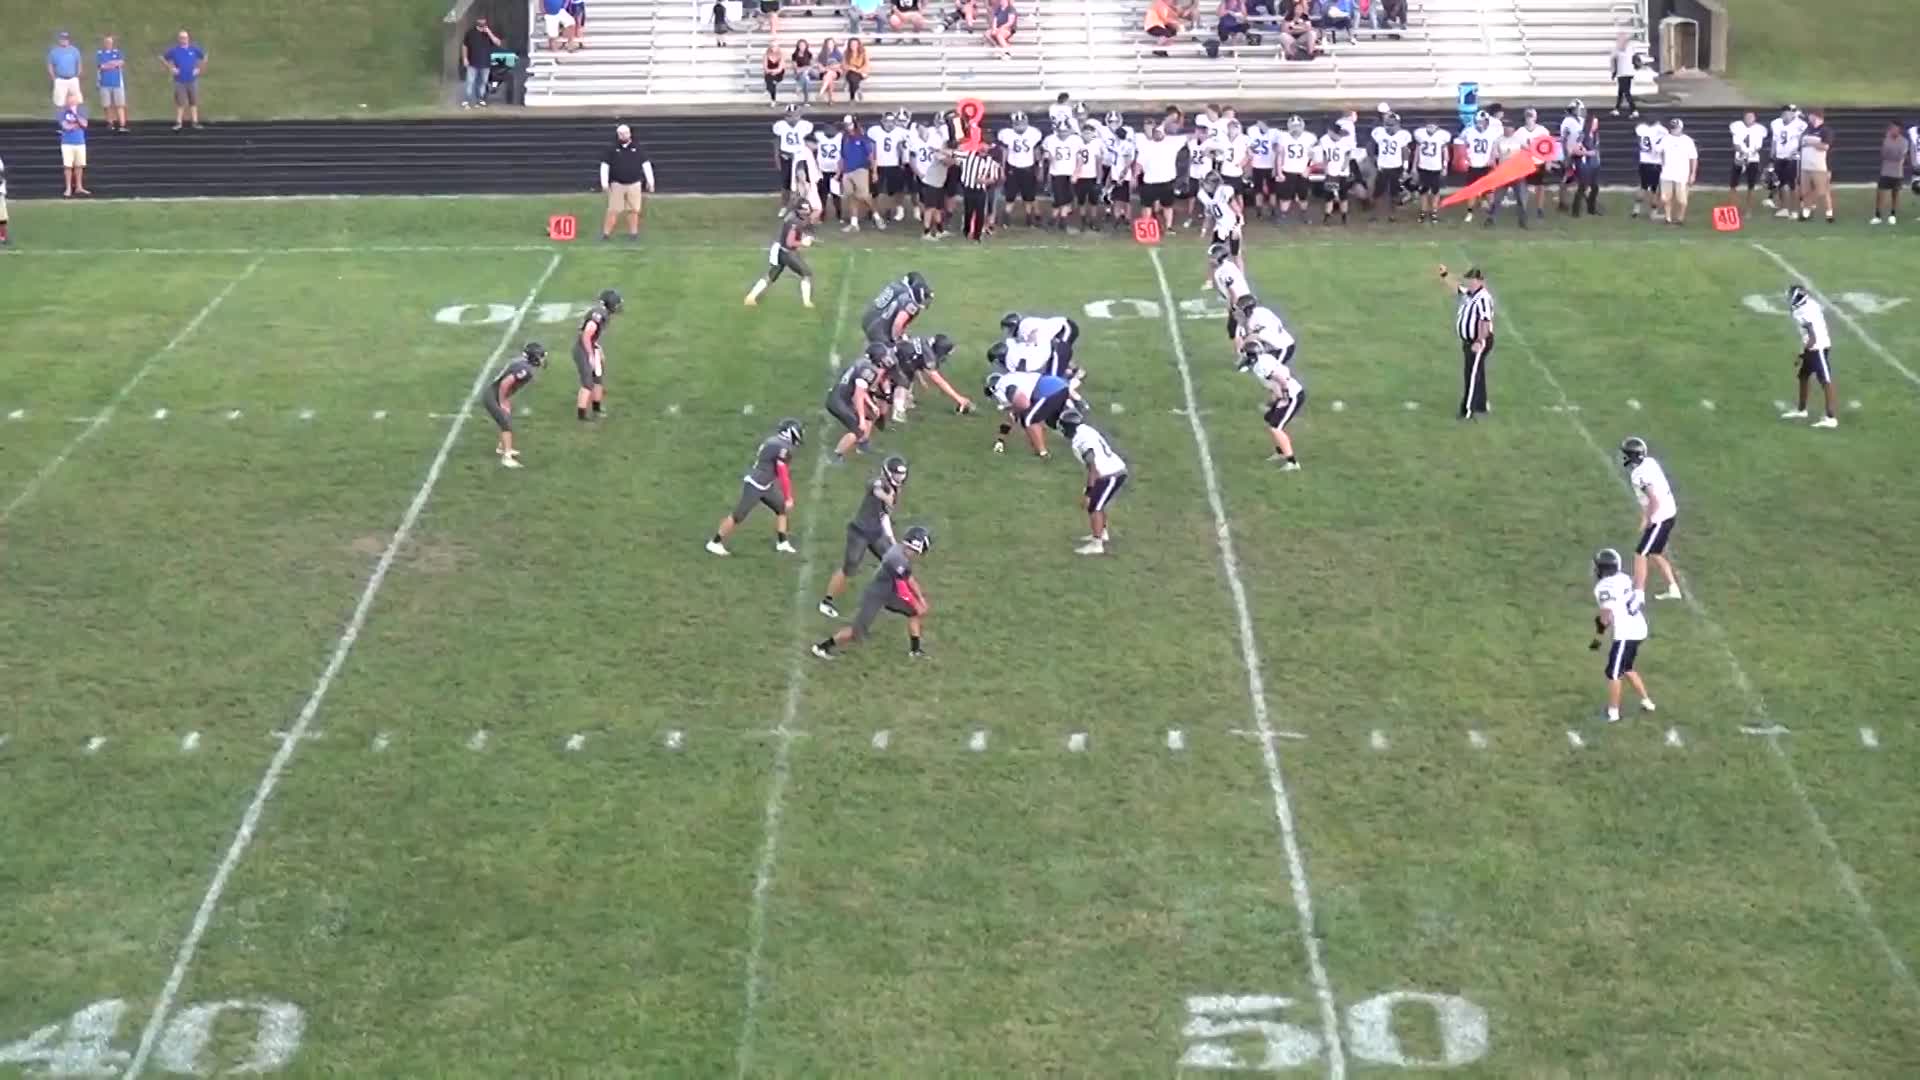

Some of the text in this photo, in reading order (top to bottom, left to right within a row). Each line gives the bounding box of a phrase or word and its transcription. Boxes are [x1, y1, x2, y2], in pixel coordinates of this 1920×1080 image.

[820, 144, 837, 159] 52
[883, 138, 891, 151] 6
[1013, 138, 1031, 153] 65
[1253, 138, 1269, 155] 25
[1287, 144, 1304, 159] 53
[1382, 138, 1398, 155] 39
[1421, 141, 1437, 157] 23
[1474, 138, 1489, 154] 20
[1718, 209, 1737, 225] 40
[554, 218, 573, 236] 40
[1137, 221, 1158, 239] 50
[0, 996, 307, 1078] 40
[1177, 990, 1489, 1071] 50
